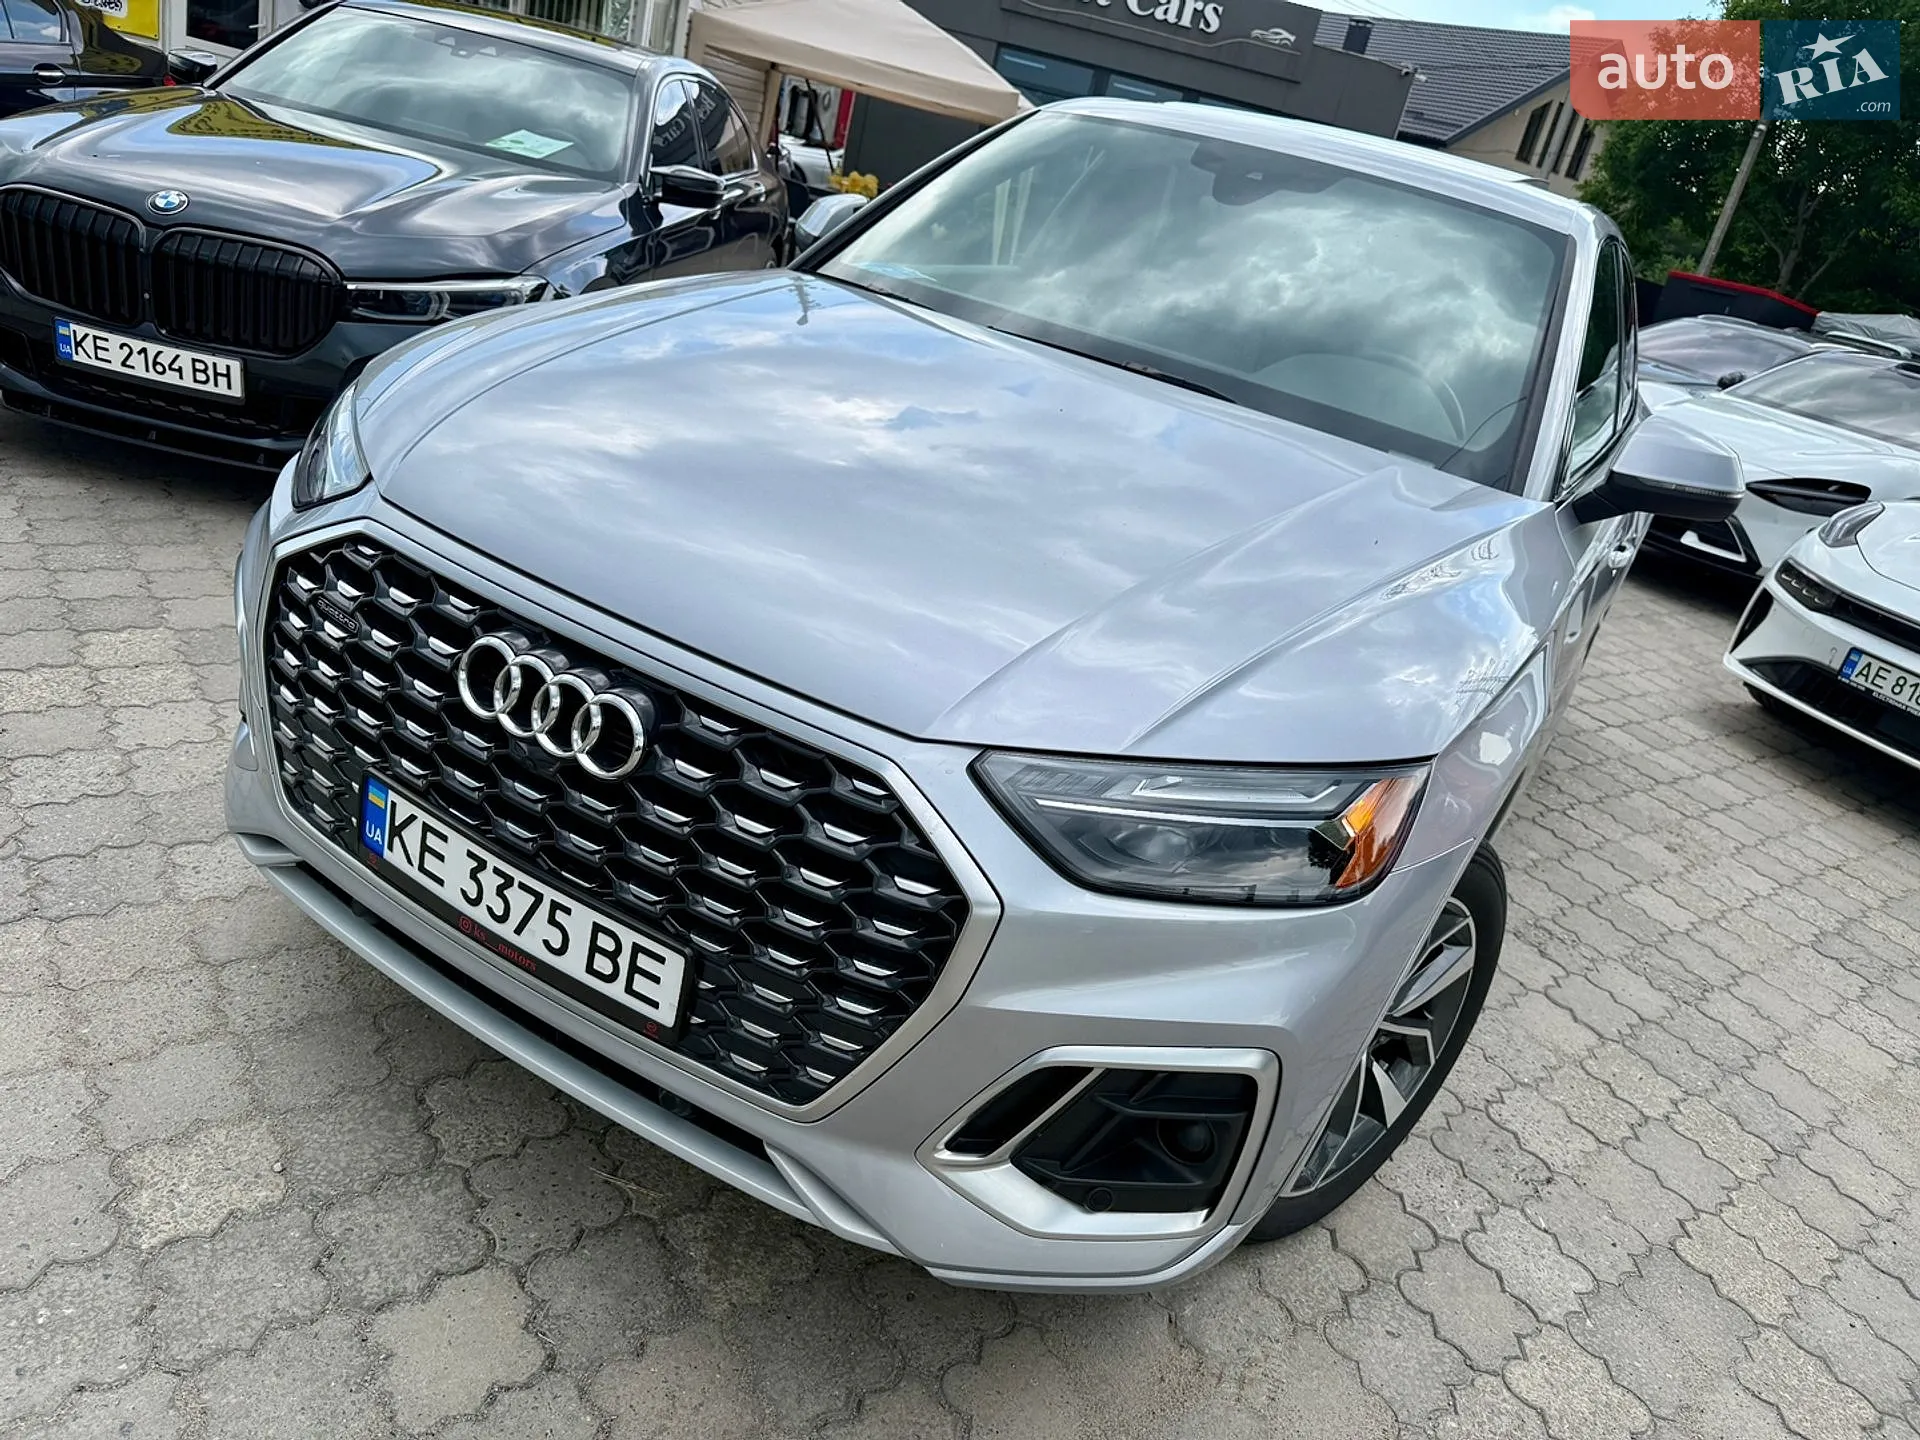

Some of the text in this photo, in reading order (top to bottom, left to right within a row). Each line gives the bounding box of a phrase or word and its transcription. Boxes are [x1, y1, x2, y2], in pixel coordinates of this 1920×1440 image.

[60, 343, 72, 354] UA
[72, 329, 232, 390] KE 2164 BH
[1854, 661, 1892, 689] AE
[1890, 675, 1920, 706] 81
[365, 819, 382, 845] UA
[386, 799, 667, 1010] KE 3375 BE
